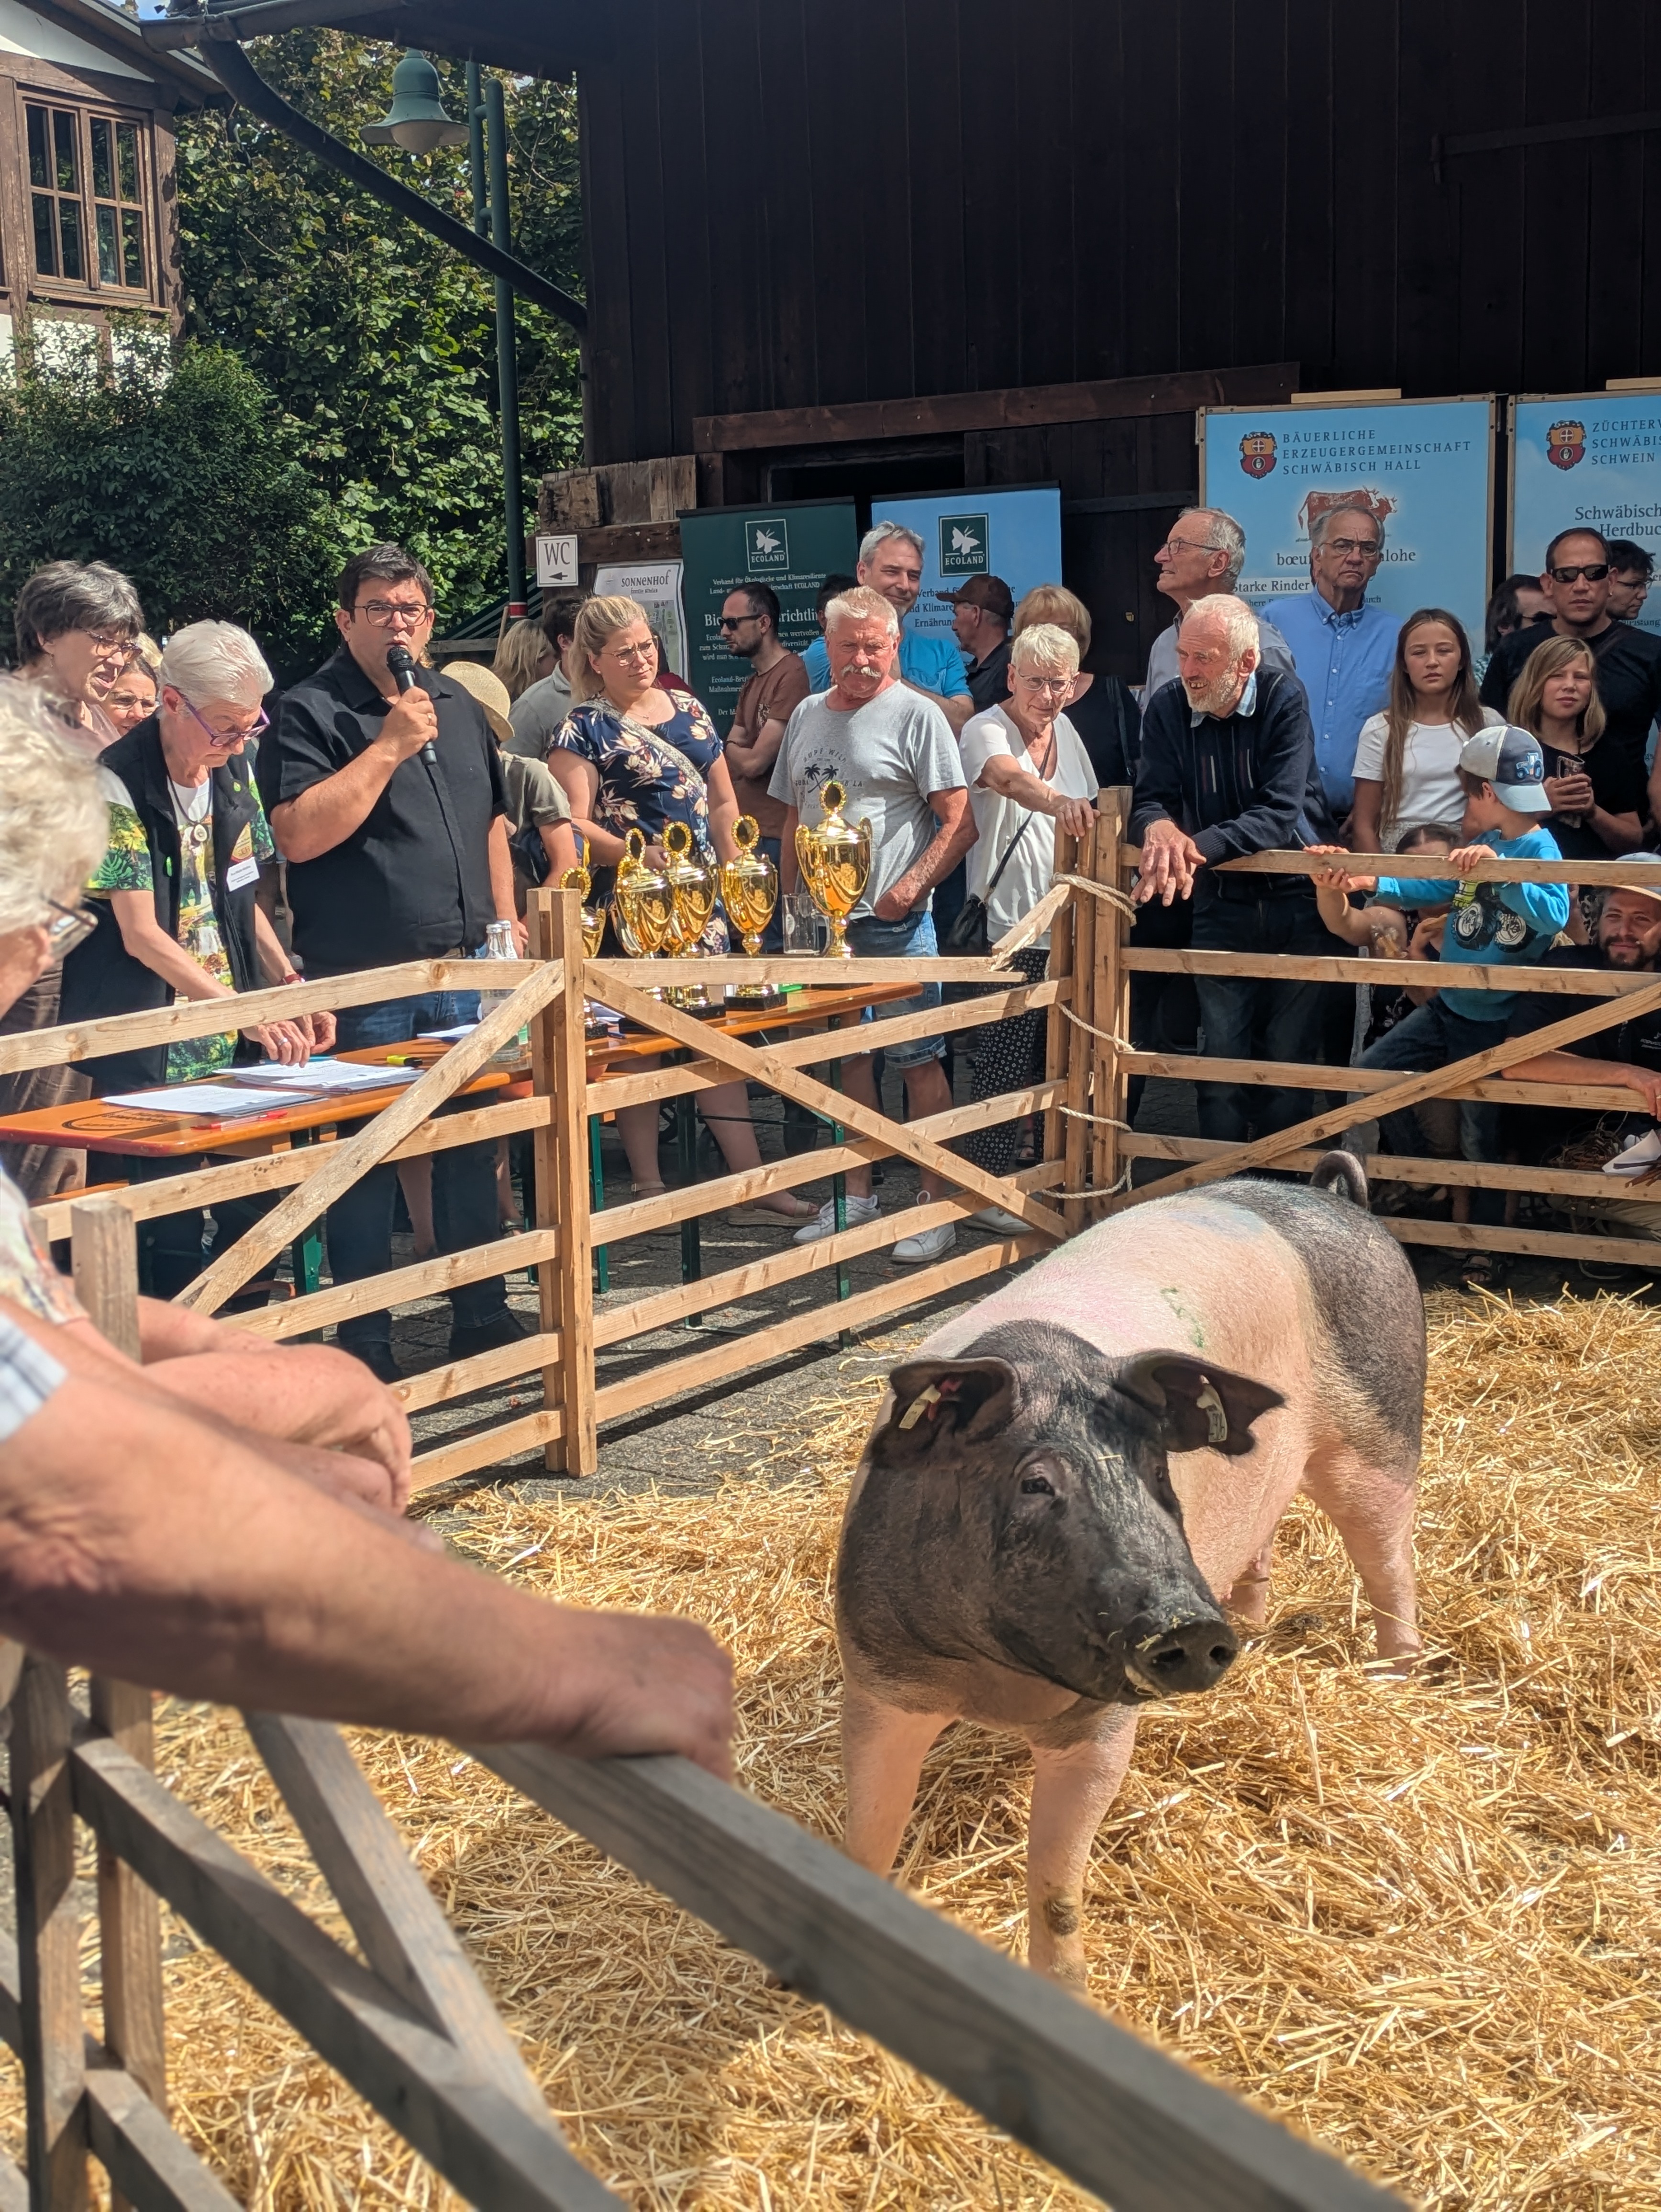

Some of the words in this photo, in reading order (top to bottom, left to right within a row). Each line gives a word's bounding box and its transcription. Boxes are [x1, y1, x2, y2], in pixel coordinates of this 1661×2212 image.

[1283, 430, 1376, 443] BÄUERLICHE
[1283, 441, 1471, 459] ERZEUGERGEMEINSCHAFT
[1591, 452, 1655, 465] SCHWEIN
[1283, 461, 1377, 475] SCHWÄBISCH
[1384, 459, 1421, 471] HALL
[544, 542, 570, 566] WC
[751, 553, 786, 563] ECOLAND
[945, 555, 984, 566] ECOLAND
[1271, 579, 1310, 591] Rinder
[915, 618, 954, 628] Ernährun
